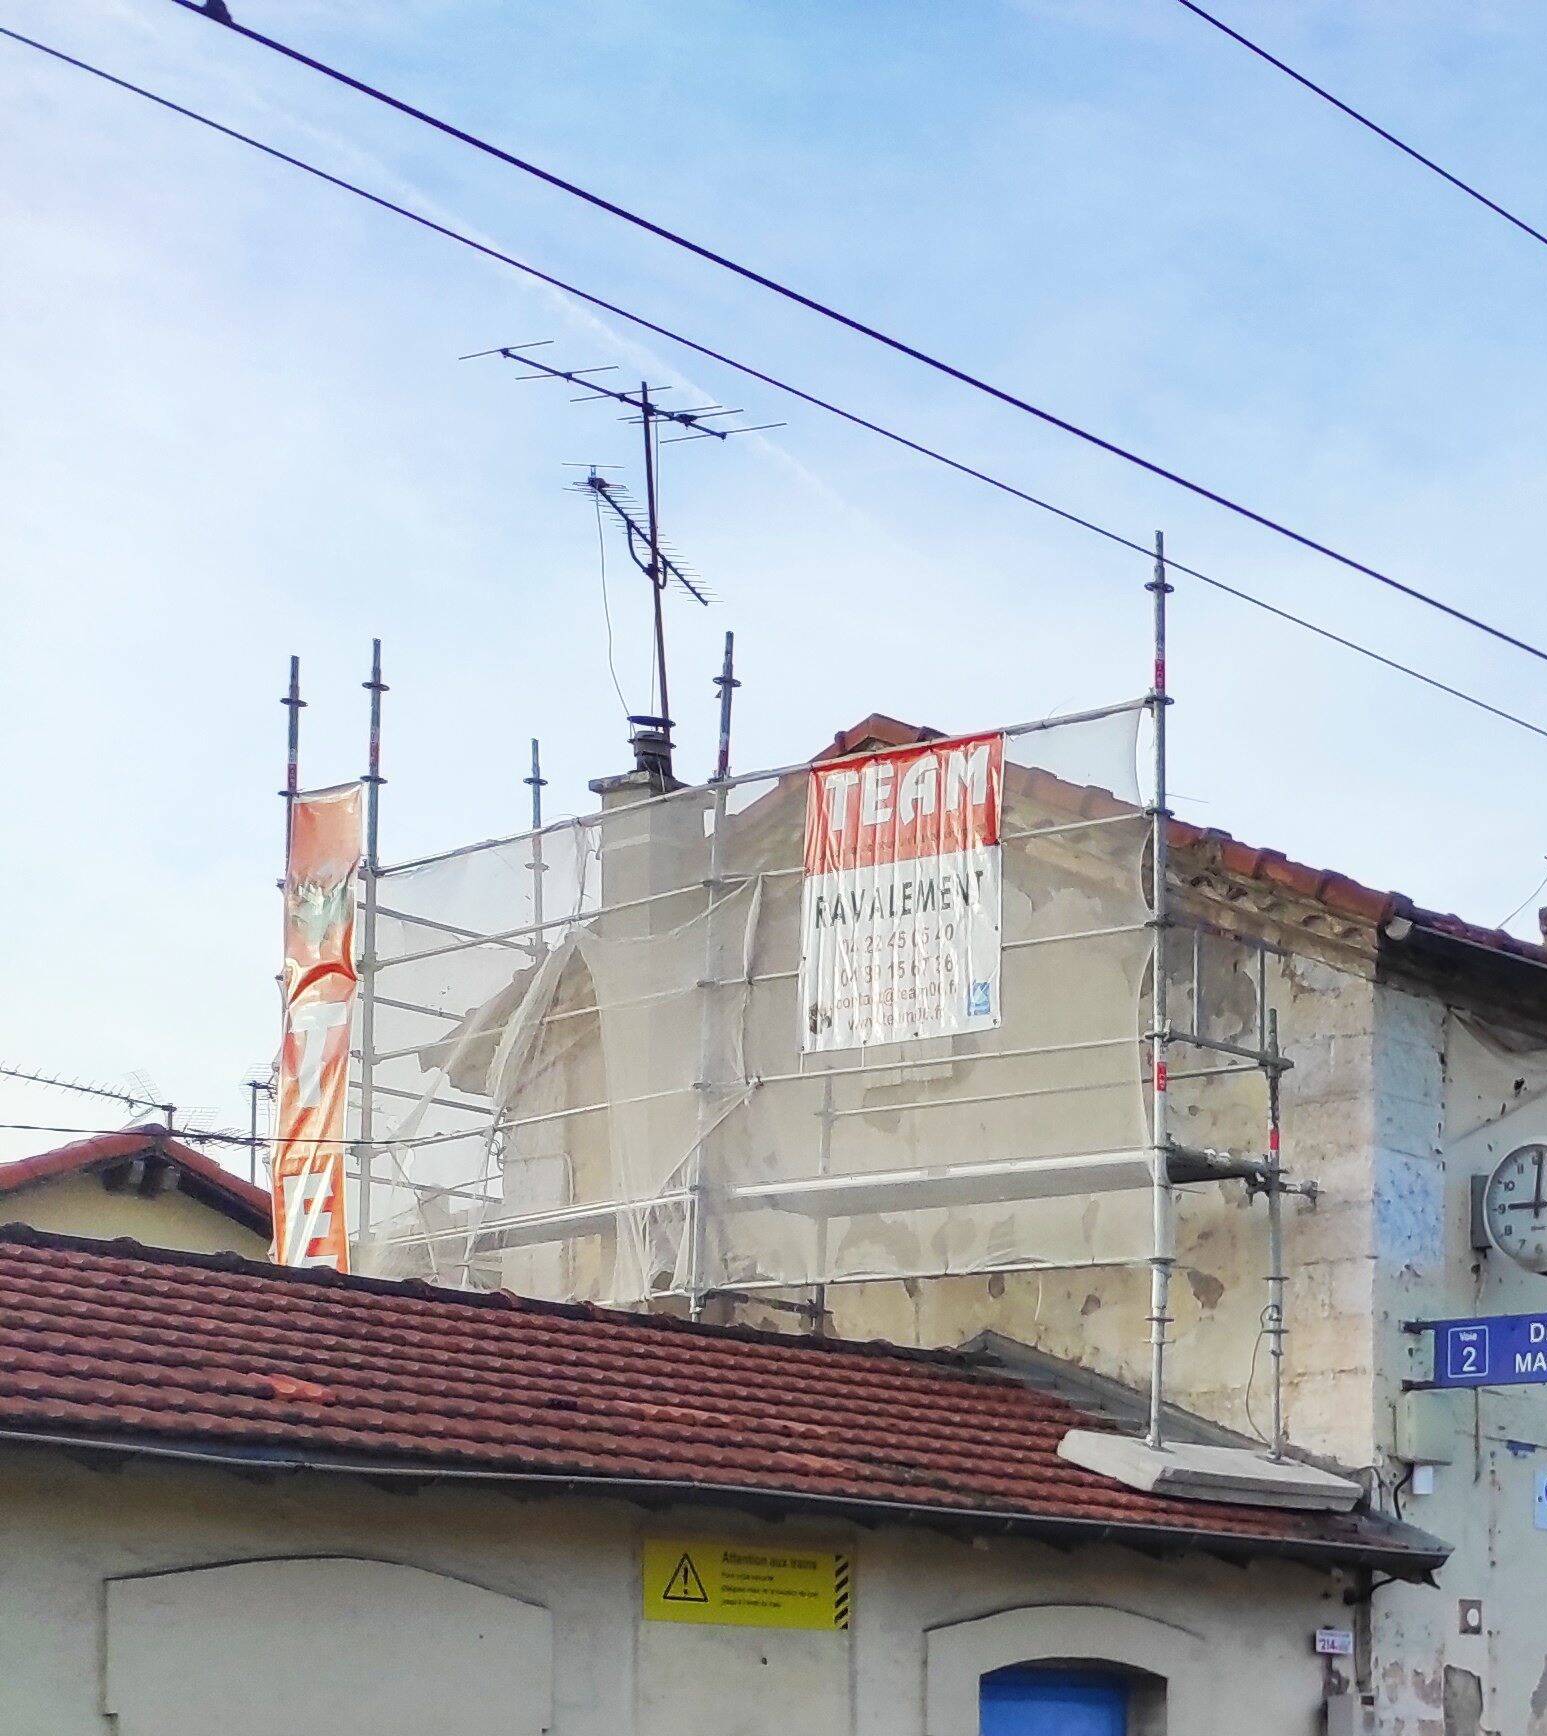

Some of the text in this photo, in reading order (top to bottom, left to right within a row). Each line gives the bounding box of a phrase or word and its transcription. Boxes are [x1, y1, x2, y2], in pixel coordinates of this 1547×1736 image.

[826, 745, 990, 832] TEAM
[815, 870, 984, 929] RAVALEMENT
[1462, 1346, 1477, 1372] 2
